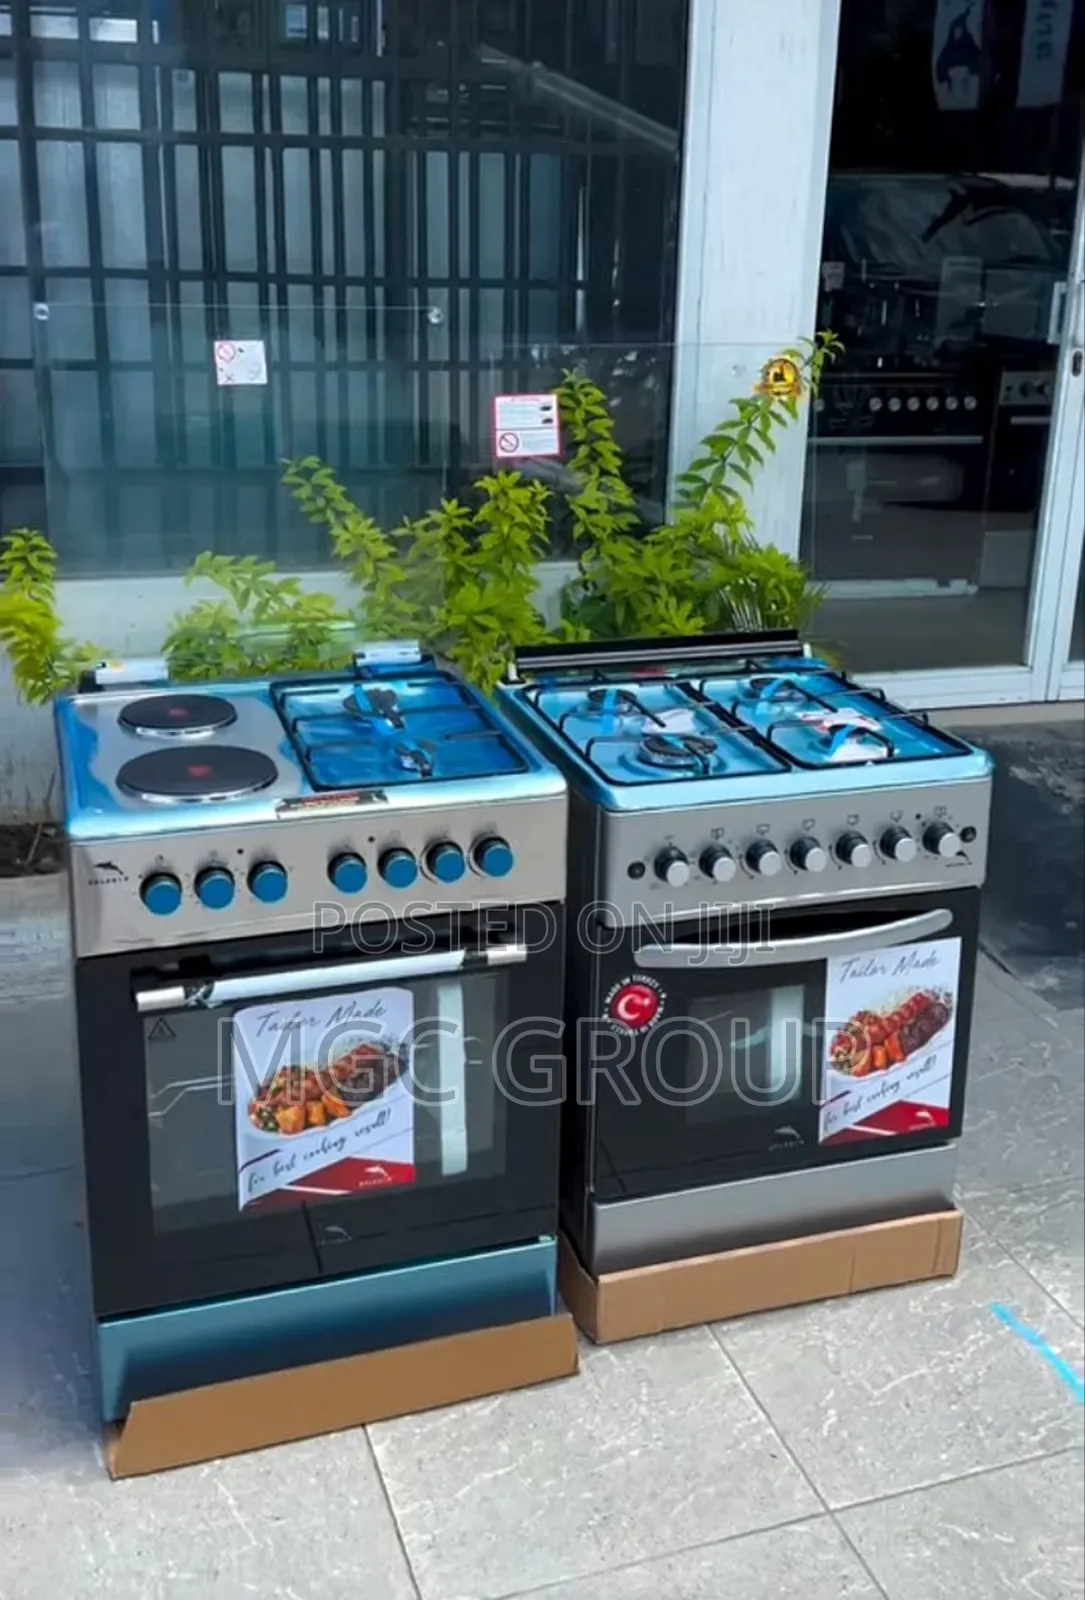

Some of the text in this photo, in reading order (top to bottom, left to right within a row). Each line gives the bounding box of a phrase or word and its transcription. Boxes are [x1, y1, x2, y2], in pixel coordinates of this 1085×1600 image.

[838, 949, 940, 983] Tailor Made
[325, 1000, 388, 1028] Made
